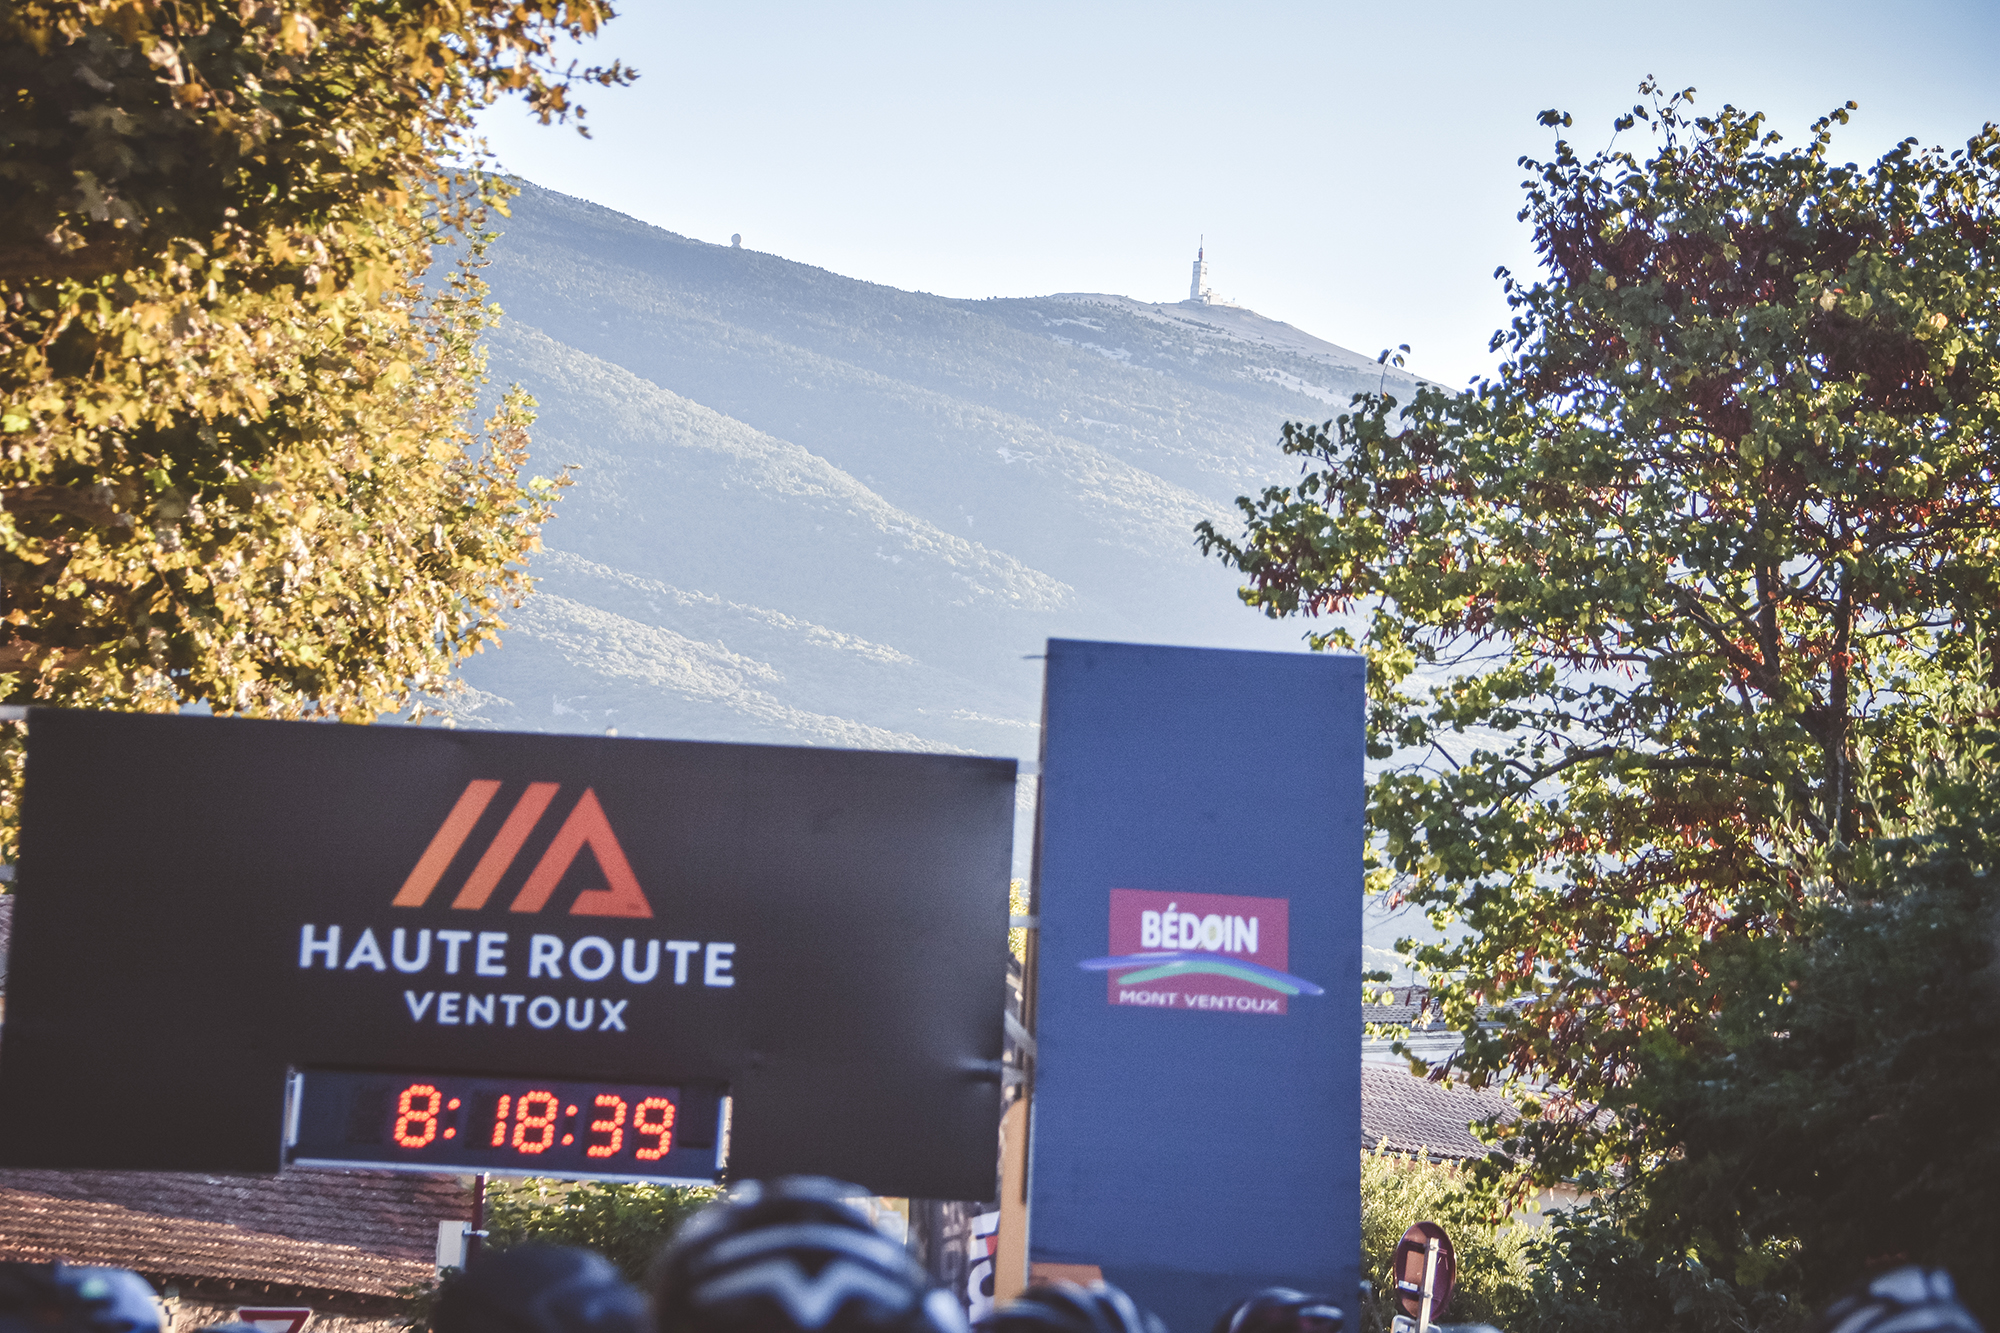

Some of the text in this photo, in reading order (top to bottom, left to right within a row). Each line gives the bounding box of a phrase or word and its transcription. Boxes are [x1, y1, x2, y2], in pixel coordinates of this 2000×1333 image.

[1141, 902, 1259, 953] BÉDOIN
[300, 925, 736, 987] HAUTE ROUTE
[404, 990, 629, 1032] VENTOUX
[1119, 990, 1279, 1012] MONT VENTOUX
